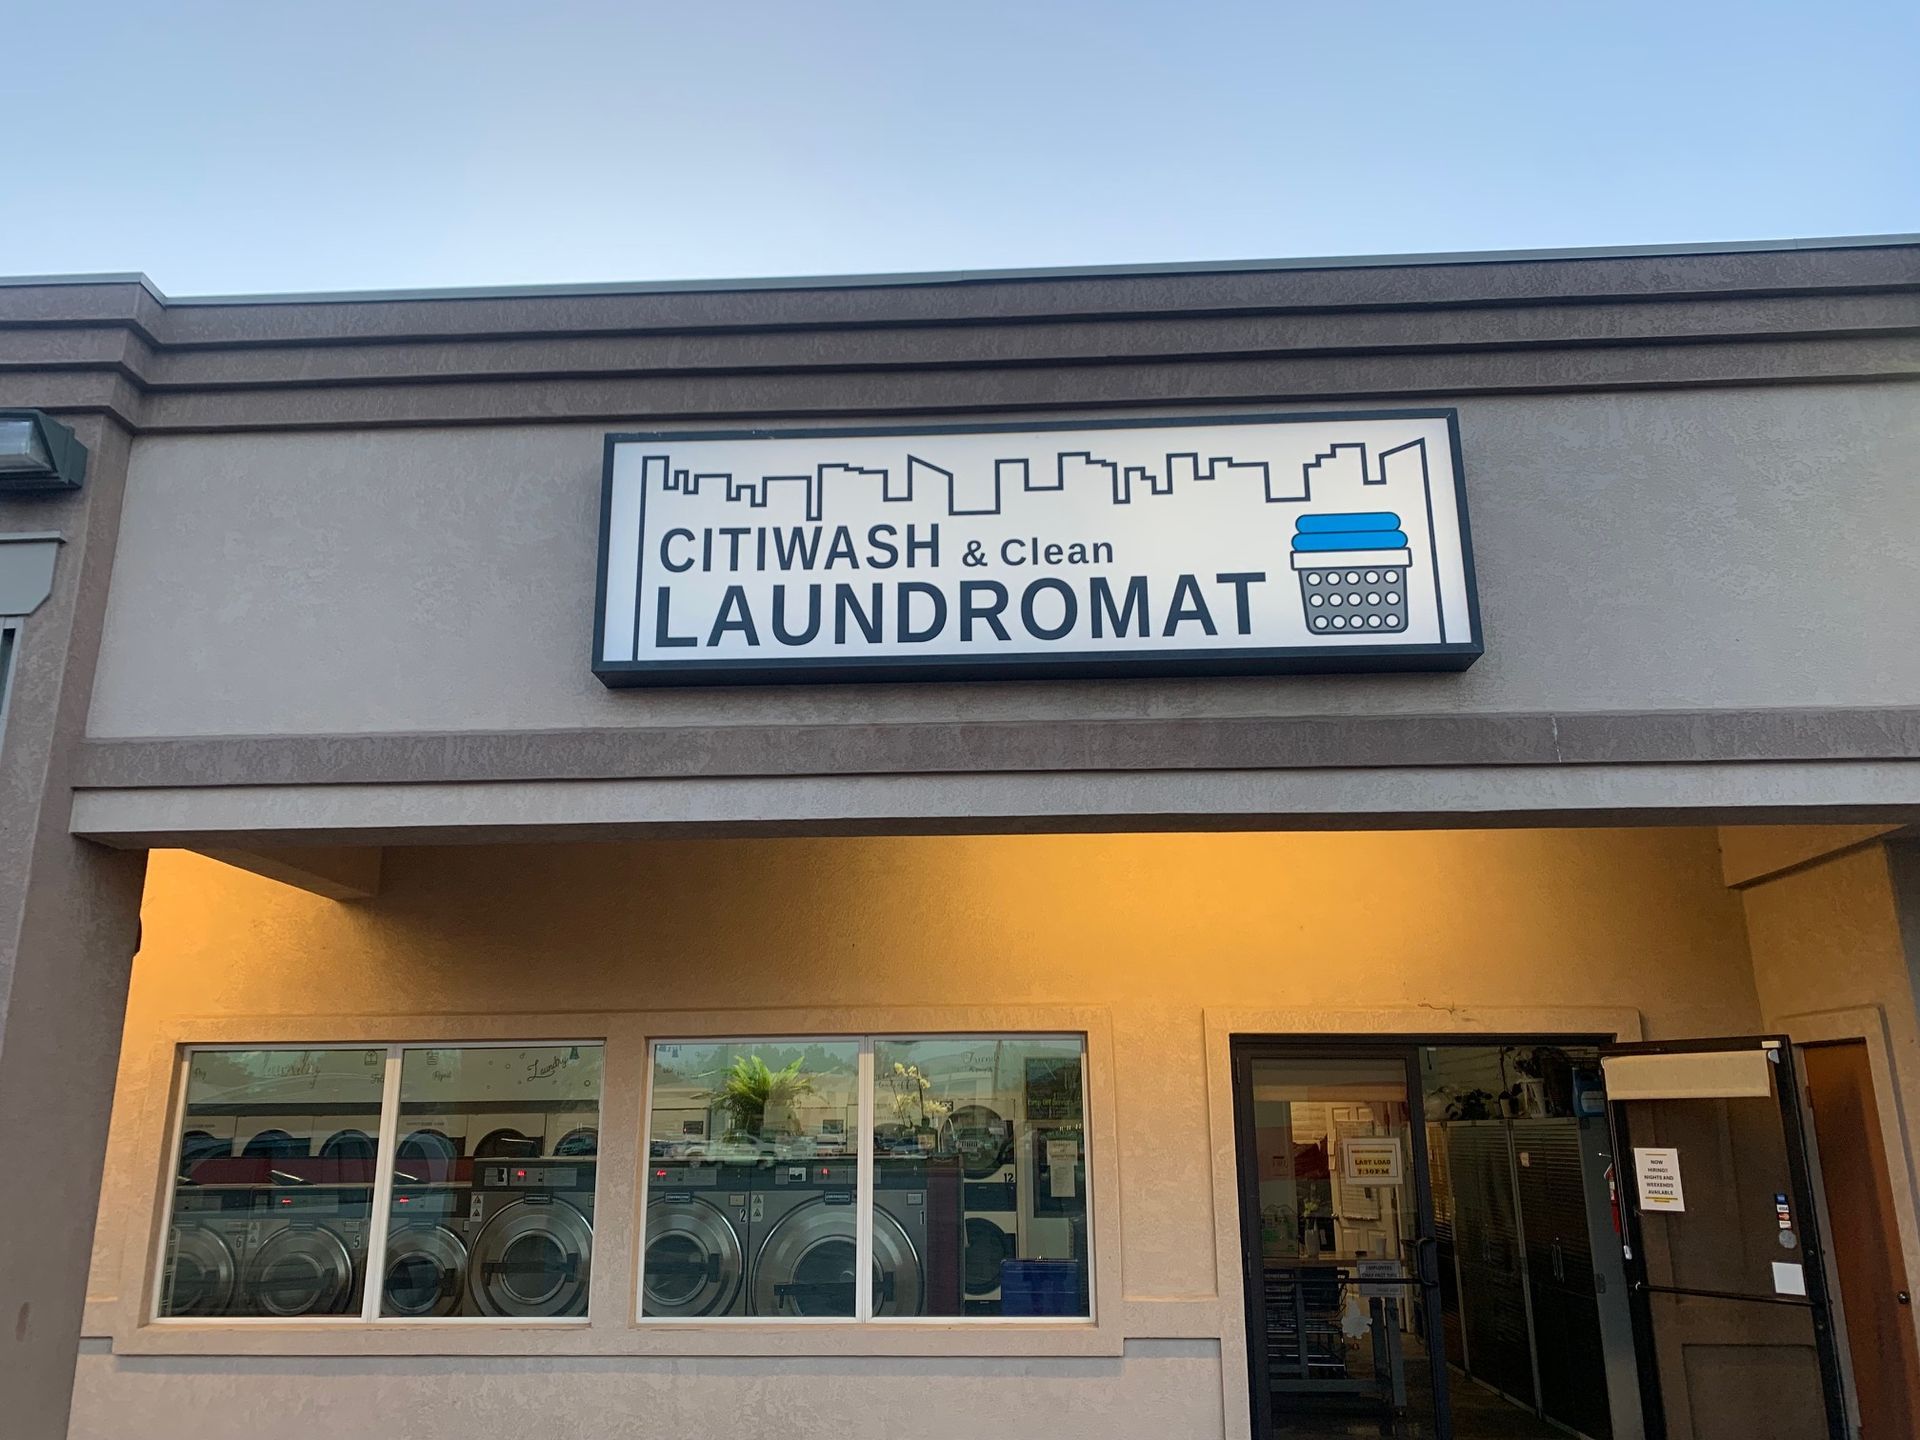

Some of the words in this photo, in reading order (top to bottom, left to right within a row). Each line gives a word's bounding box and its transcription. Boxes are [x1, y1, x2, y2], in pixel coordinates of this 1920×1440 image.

[660, 524, 940, 572] CITIWASH
[963, 541, 988, 567] &
[1001, 538, 1113, 566] Clean
[656, 572, 1267, 647] LAUNDROMAT
[527, 1056, 569, 1082] Laundry
[1003, 1172, 1014, 1183] 12
[739, 1209, 747, 1223] 2
[919, 1210, 925, 1225] 1
[235, 1235, 243, 1249] 6
[353, 1234, 360, 1249] 5
